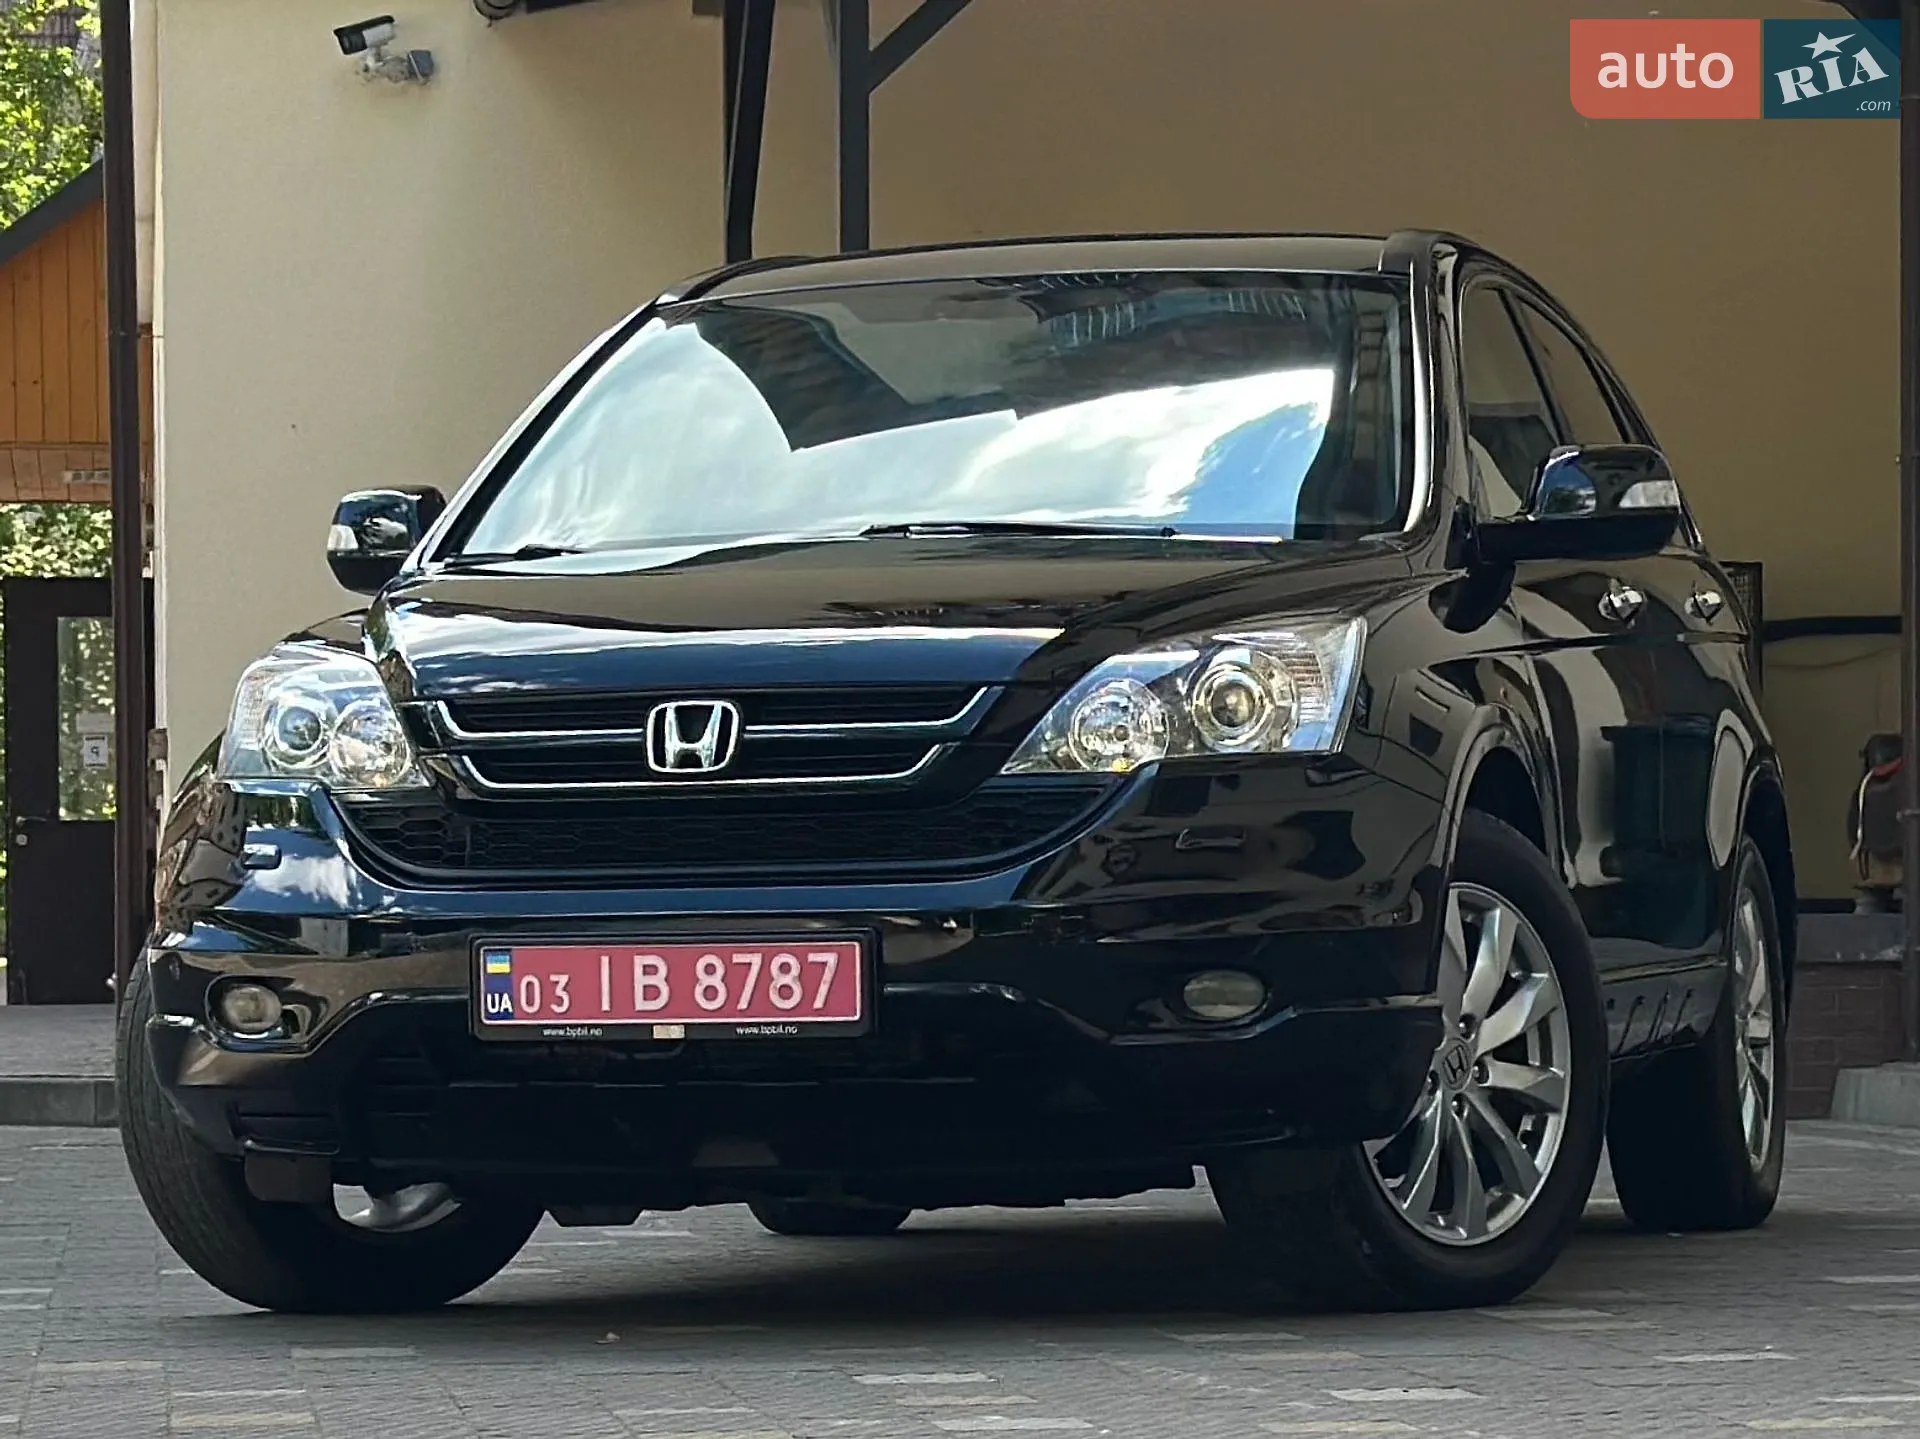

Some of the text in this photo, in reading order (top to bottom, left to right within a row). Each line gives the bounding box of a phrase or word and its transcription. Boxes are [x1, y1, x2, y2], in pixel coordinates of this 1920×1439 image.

[486, 993, 513, 1014] UA
[519, 974, 570, 1014] 03
[694, 952, 839, 1011] 8787
